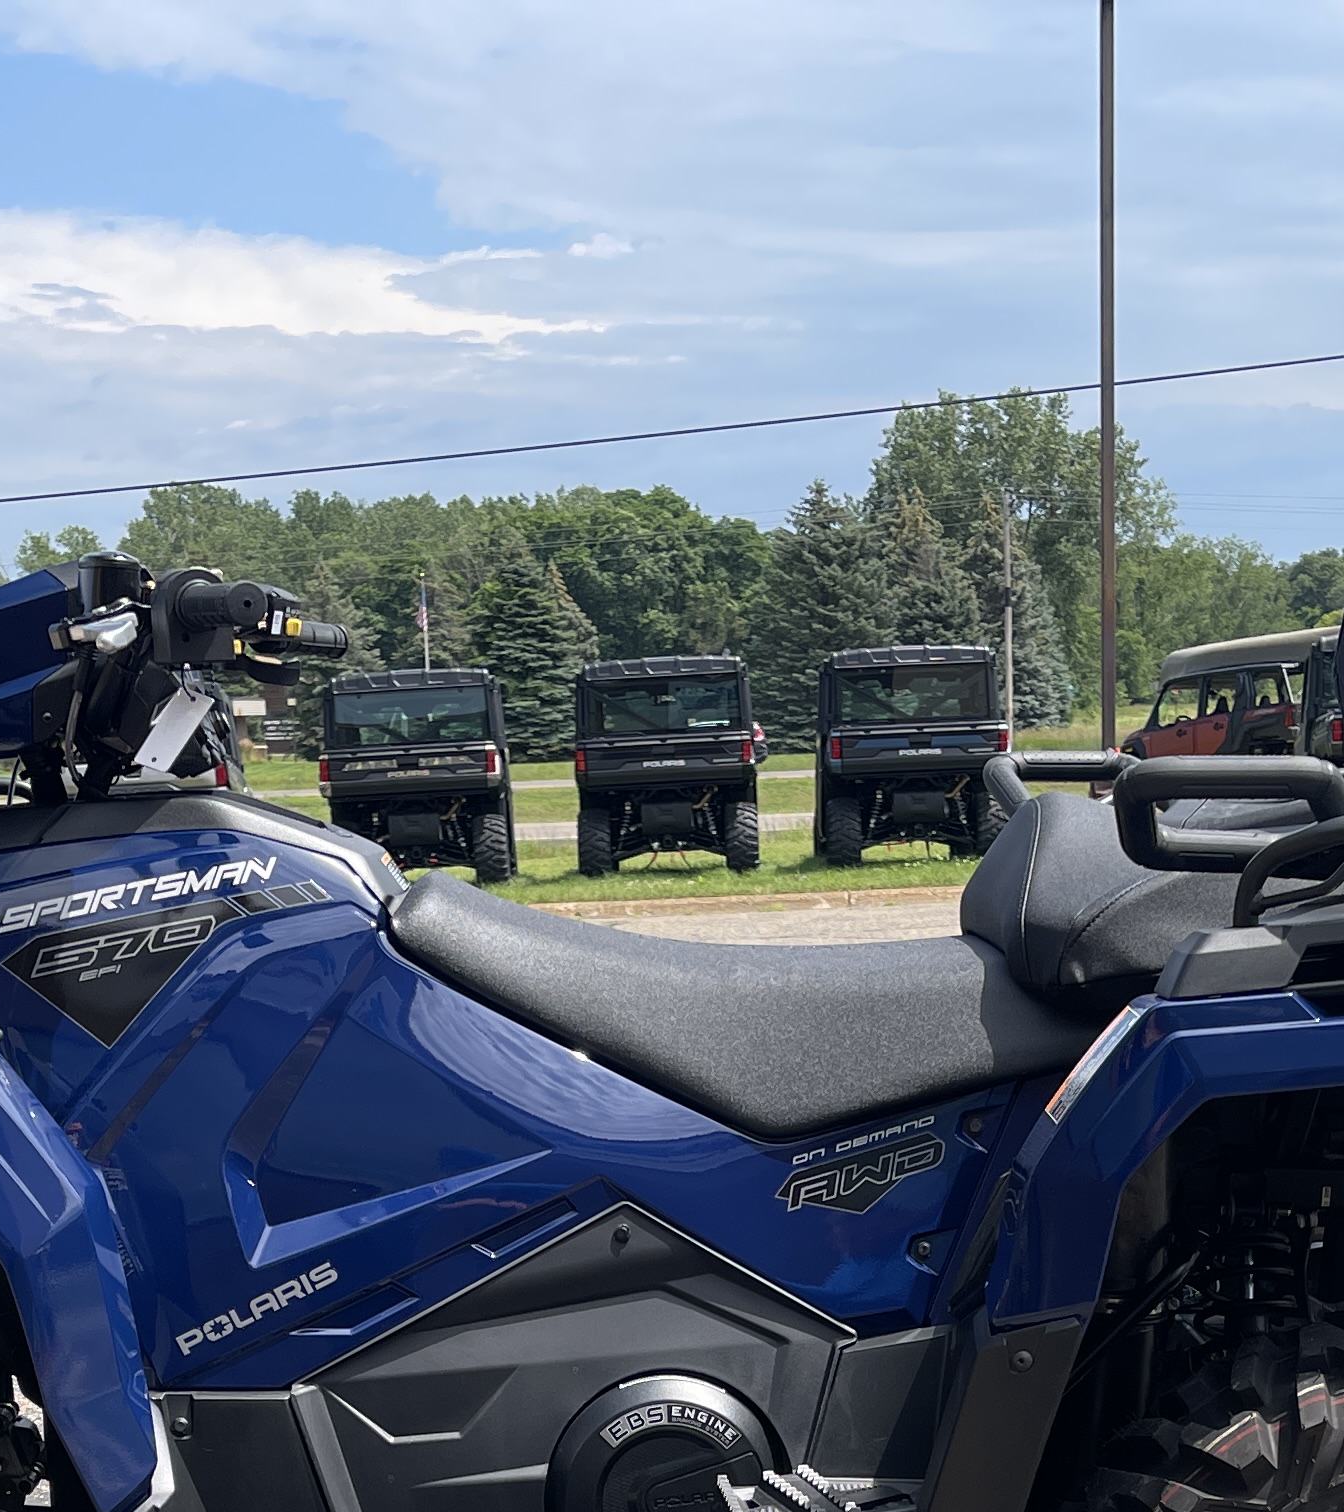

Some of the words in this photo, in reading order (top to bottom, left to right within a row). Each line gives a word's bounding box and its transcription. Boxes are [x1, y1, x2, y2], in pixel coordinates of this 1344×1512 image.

[642, 759, 686, 768] POLARIS
[898, 748, 942, 757] POLARIS
[31, 914, 217, 979] 570
[79, 964, 121, 982] EFI
[792, 1148, 825, 1165] ON
[835, 1115, 935, 1153] DEMAND
[787, 1138, 946, 1212] AWD
[175, 1261, 339, 1356] POLARIS
[607, 1406, 664, 1442] EBS
[671, 1405, 737, 1441] ENGINE
